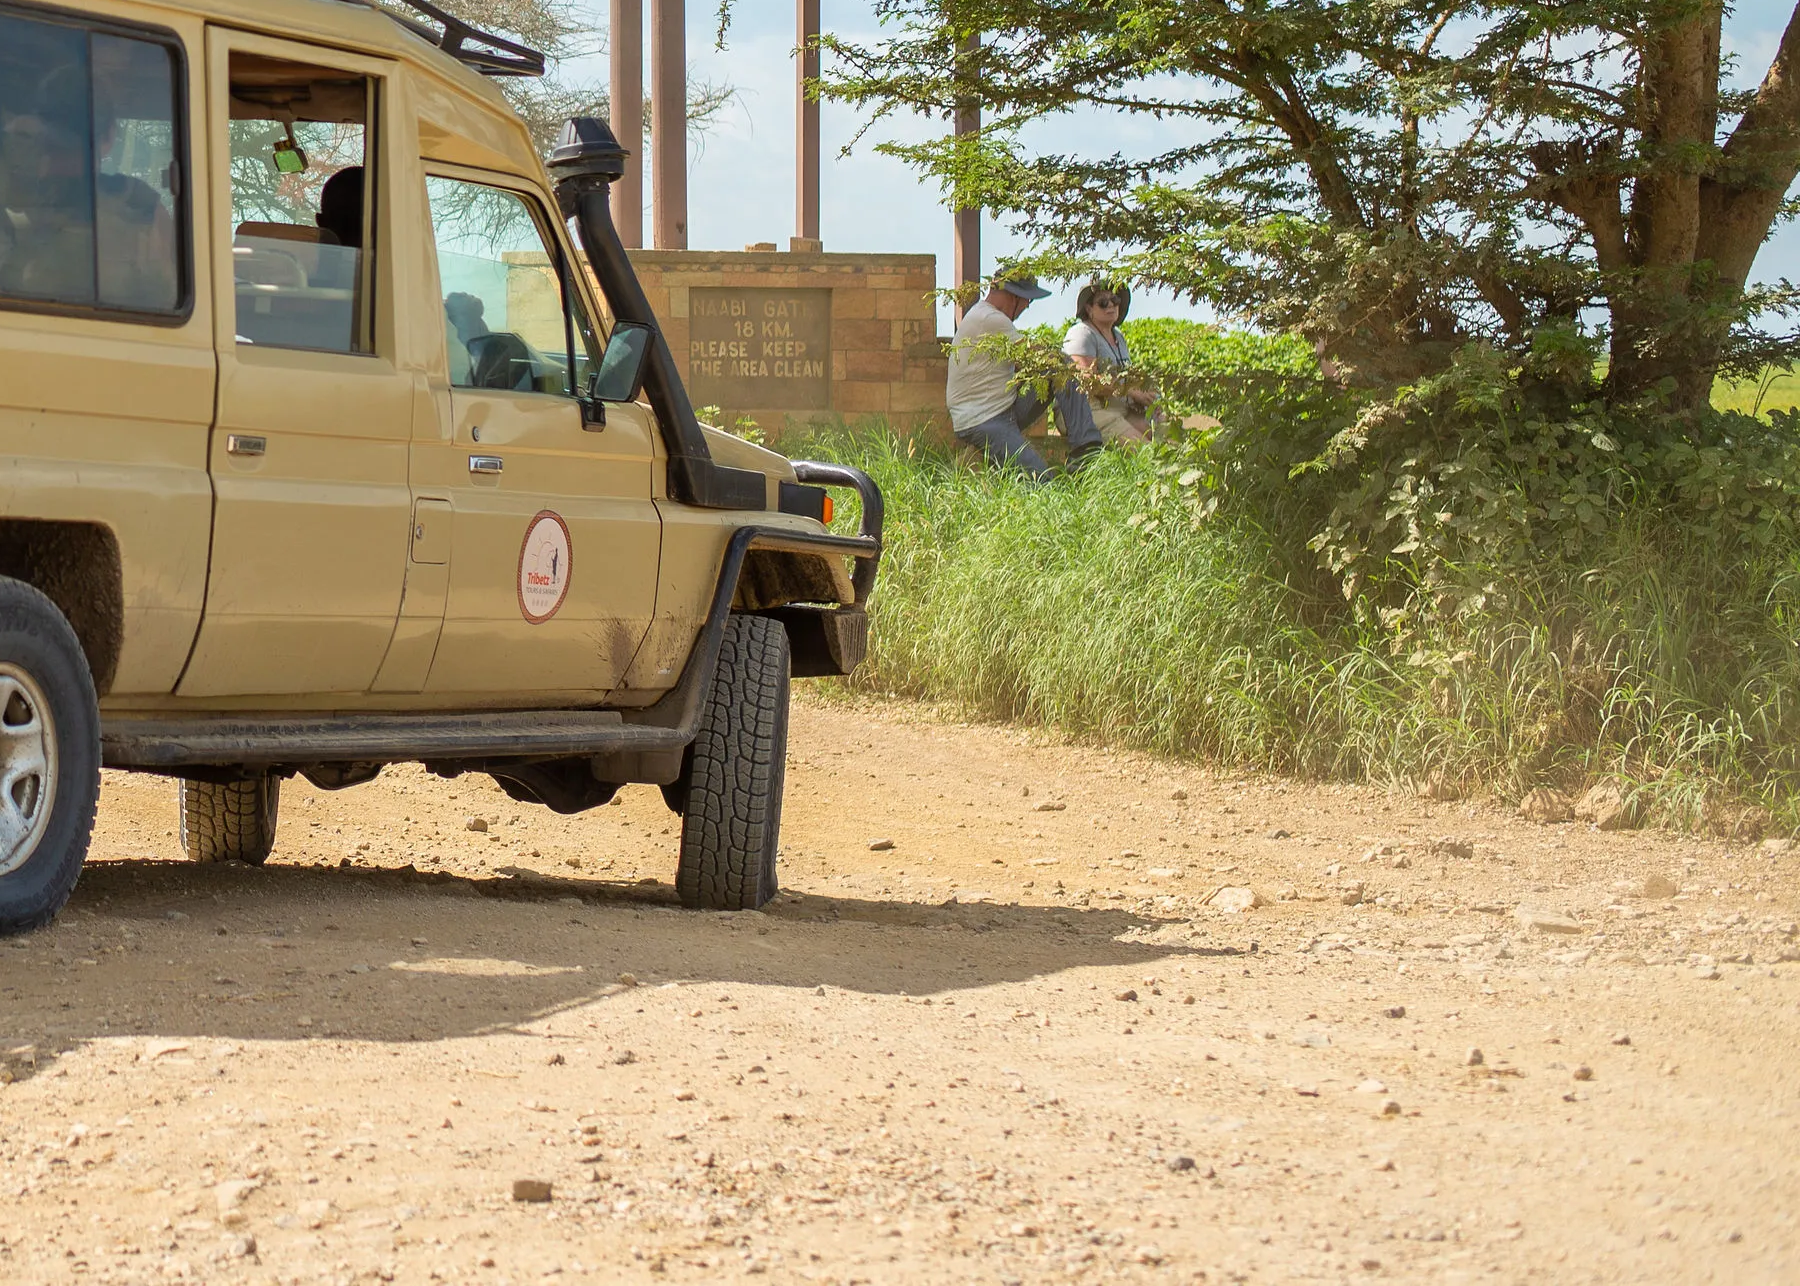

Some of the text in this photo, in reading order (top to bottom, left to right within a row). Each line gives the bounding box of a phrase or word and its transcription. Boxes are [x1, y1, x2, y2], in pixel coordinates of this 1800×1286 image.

[693, 298, 746, 316] NAABI
[734, 320, 755, 338] 18
[690, 341, 807, 358] PLEASE KEEP
[691, 360, 824, 378] THE AREA CLEAN
[528, 572, 550, 585] Tribetz
